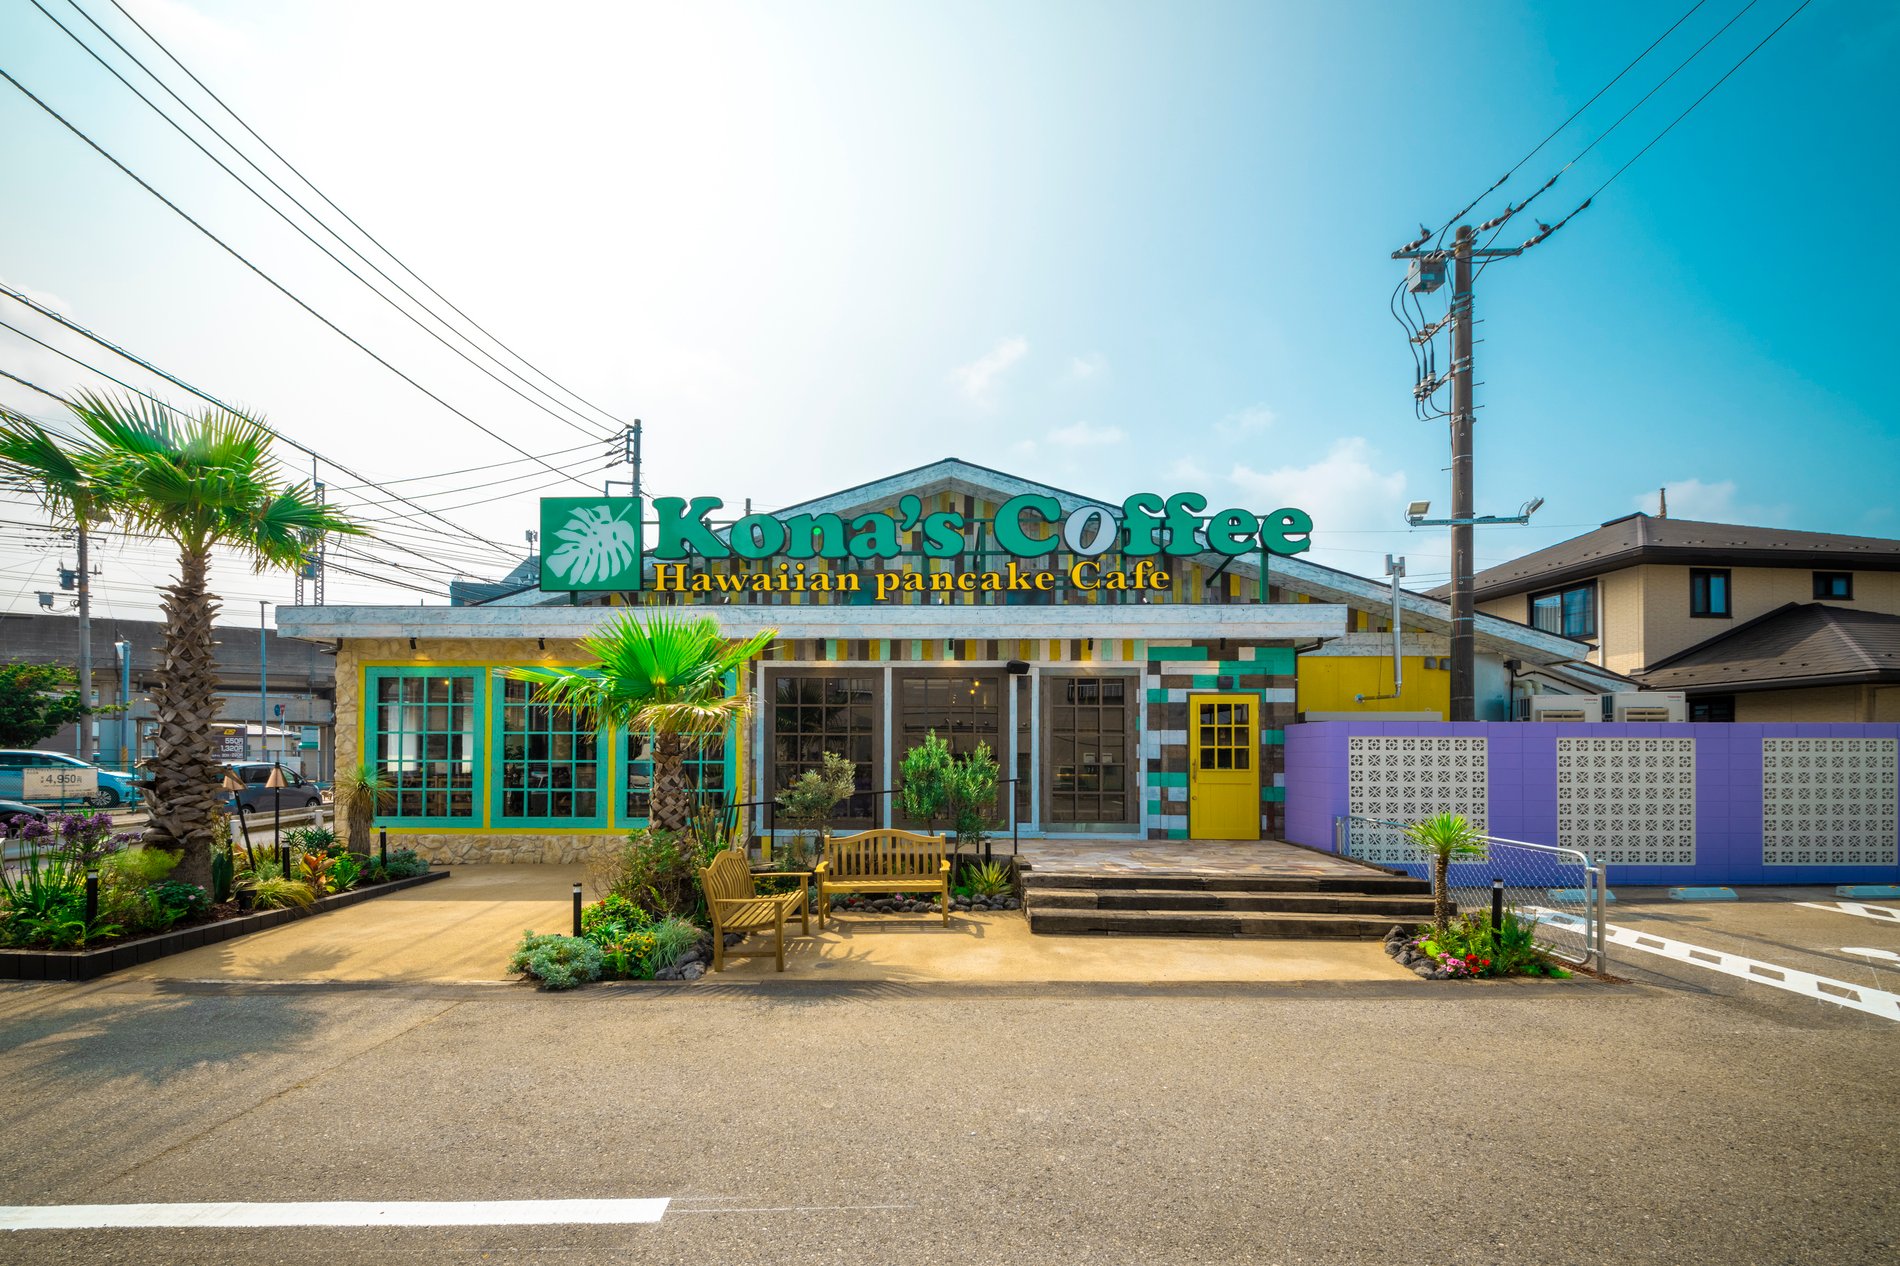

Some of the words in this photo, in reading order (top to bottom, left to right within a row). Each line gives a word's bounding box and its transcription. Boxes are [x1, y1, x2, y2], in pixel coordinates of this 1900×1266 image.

[652, 494, 965, 560] Kona's
[993, 491, 1314, 558] Coffee
[652, 562, 861, 593] Hawaiian
[874, 561, 1055, 601] pancake
[1070, 560, 1171, 592] Cafe
